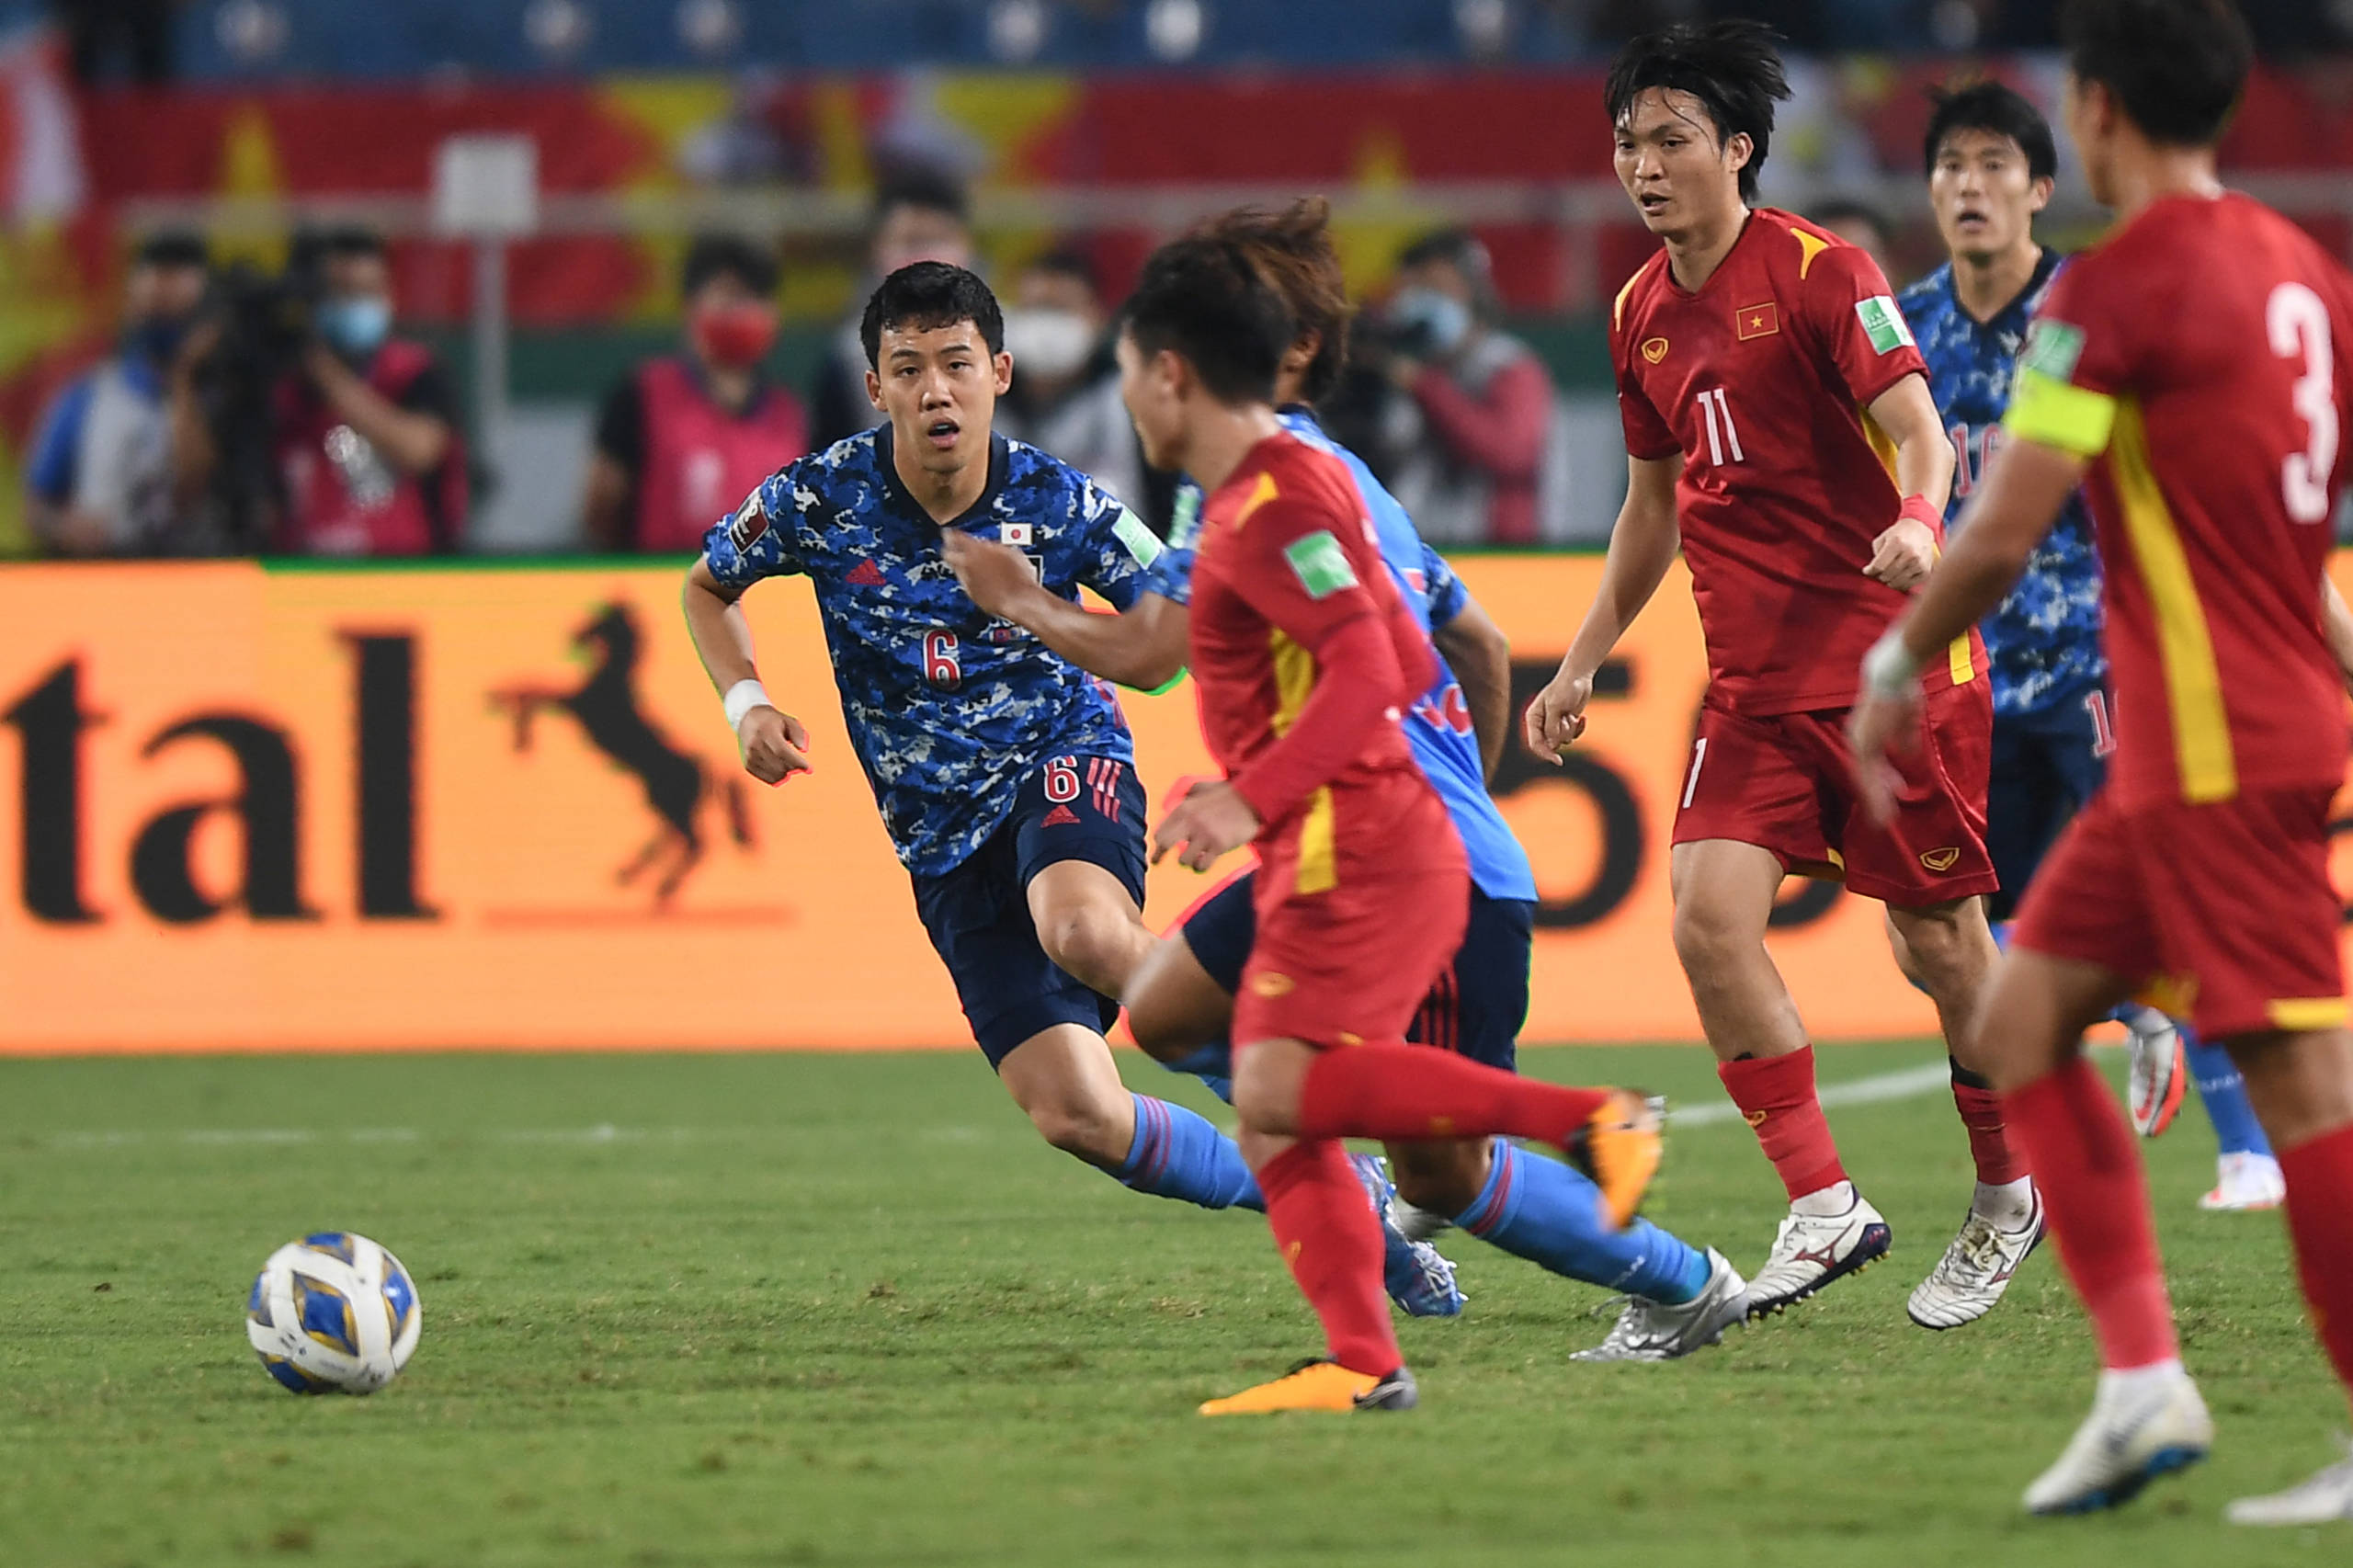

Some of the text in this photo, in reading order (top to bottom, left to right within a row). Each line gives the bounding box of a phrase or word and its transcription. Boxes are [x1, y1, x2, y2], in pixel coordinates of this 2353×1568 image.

[1698, 388, 1744, 466] 11
[2267, 281, 2339, 524] 3
[923, 629, 962, 692] 6
[2084, 689, 2119, 756] 1
[3, 628, 445, 925] tal
[1044, 756, 1081, 802] 6
